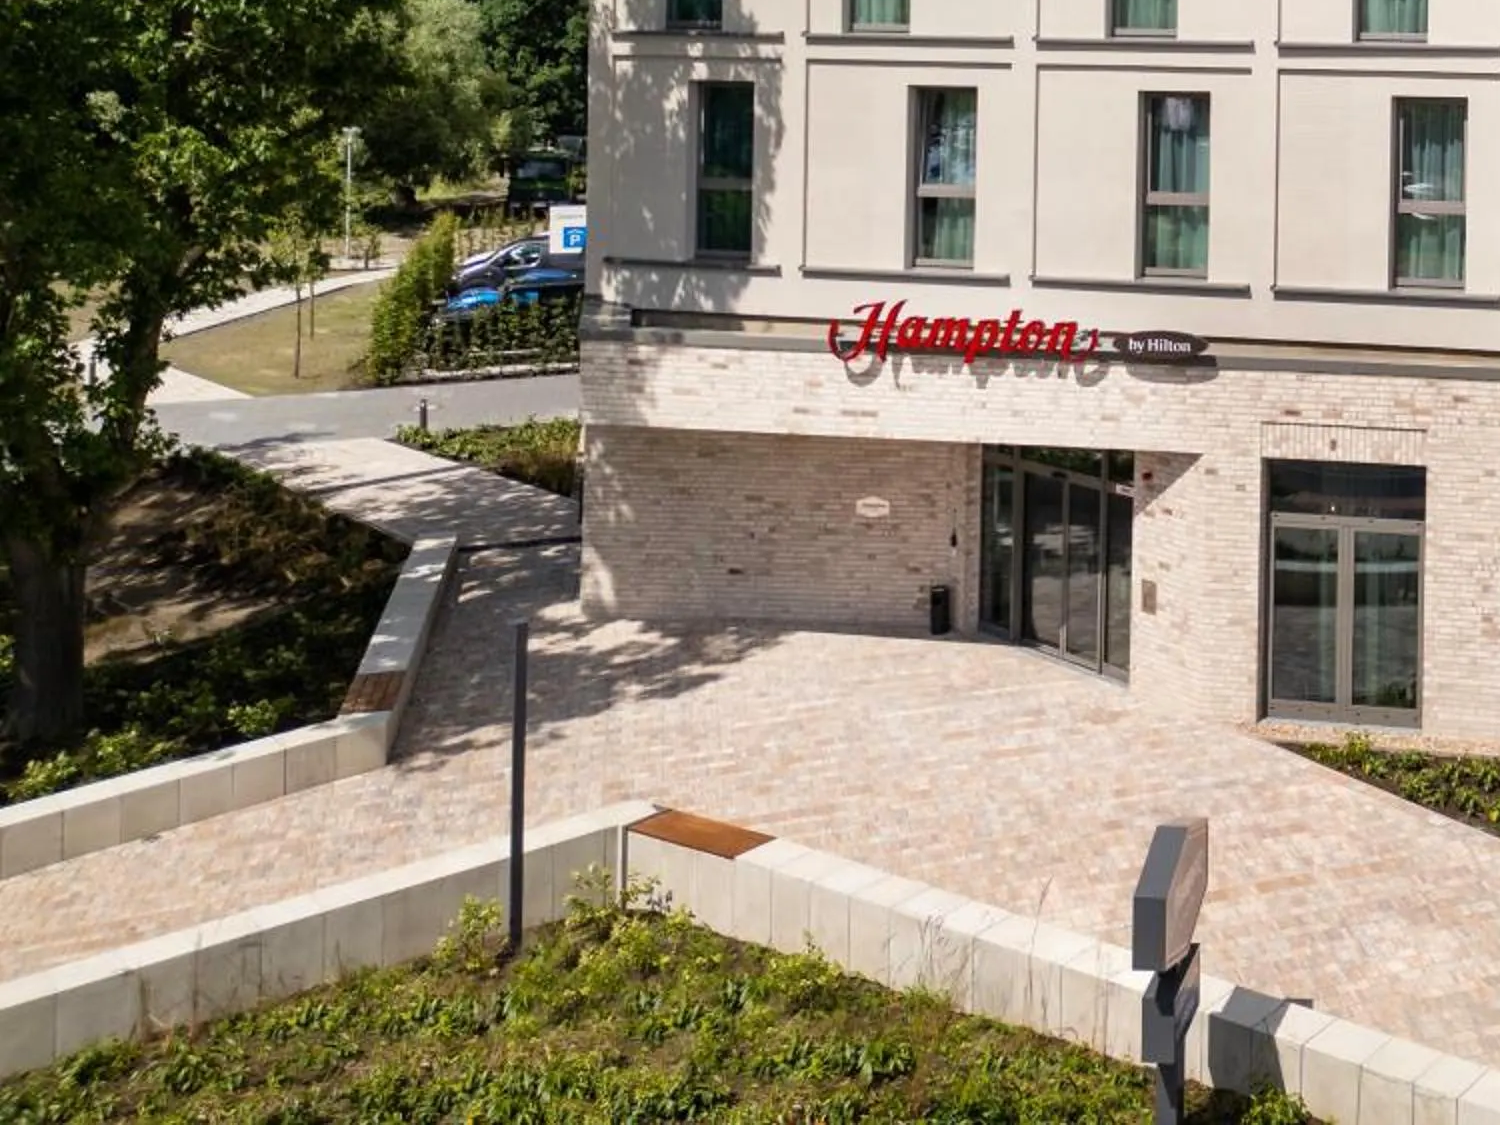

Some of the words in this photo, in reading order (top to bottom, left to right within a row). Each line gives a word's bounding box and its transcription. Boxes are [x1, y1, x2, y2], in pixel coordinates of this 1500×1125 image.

[828, 299, 1099, 364] Hampton
[1129, 337, 1145, 354] by
[1147, 338, 1191, 352] Hilton
